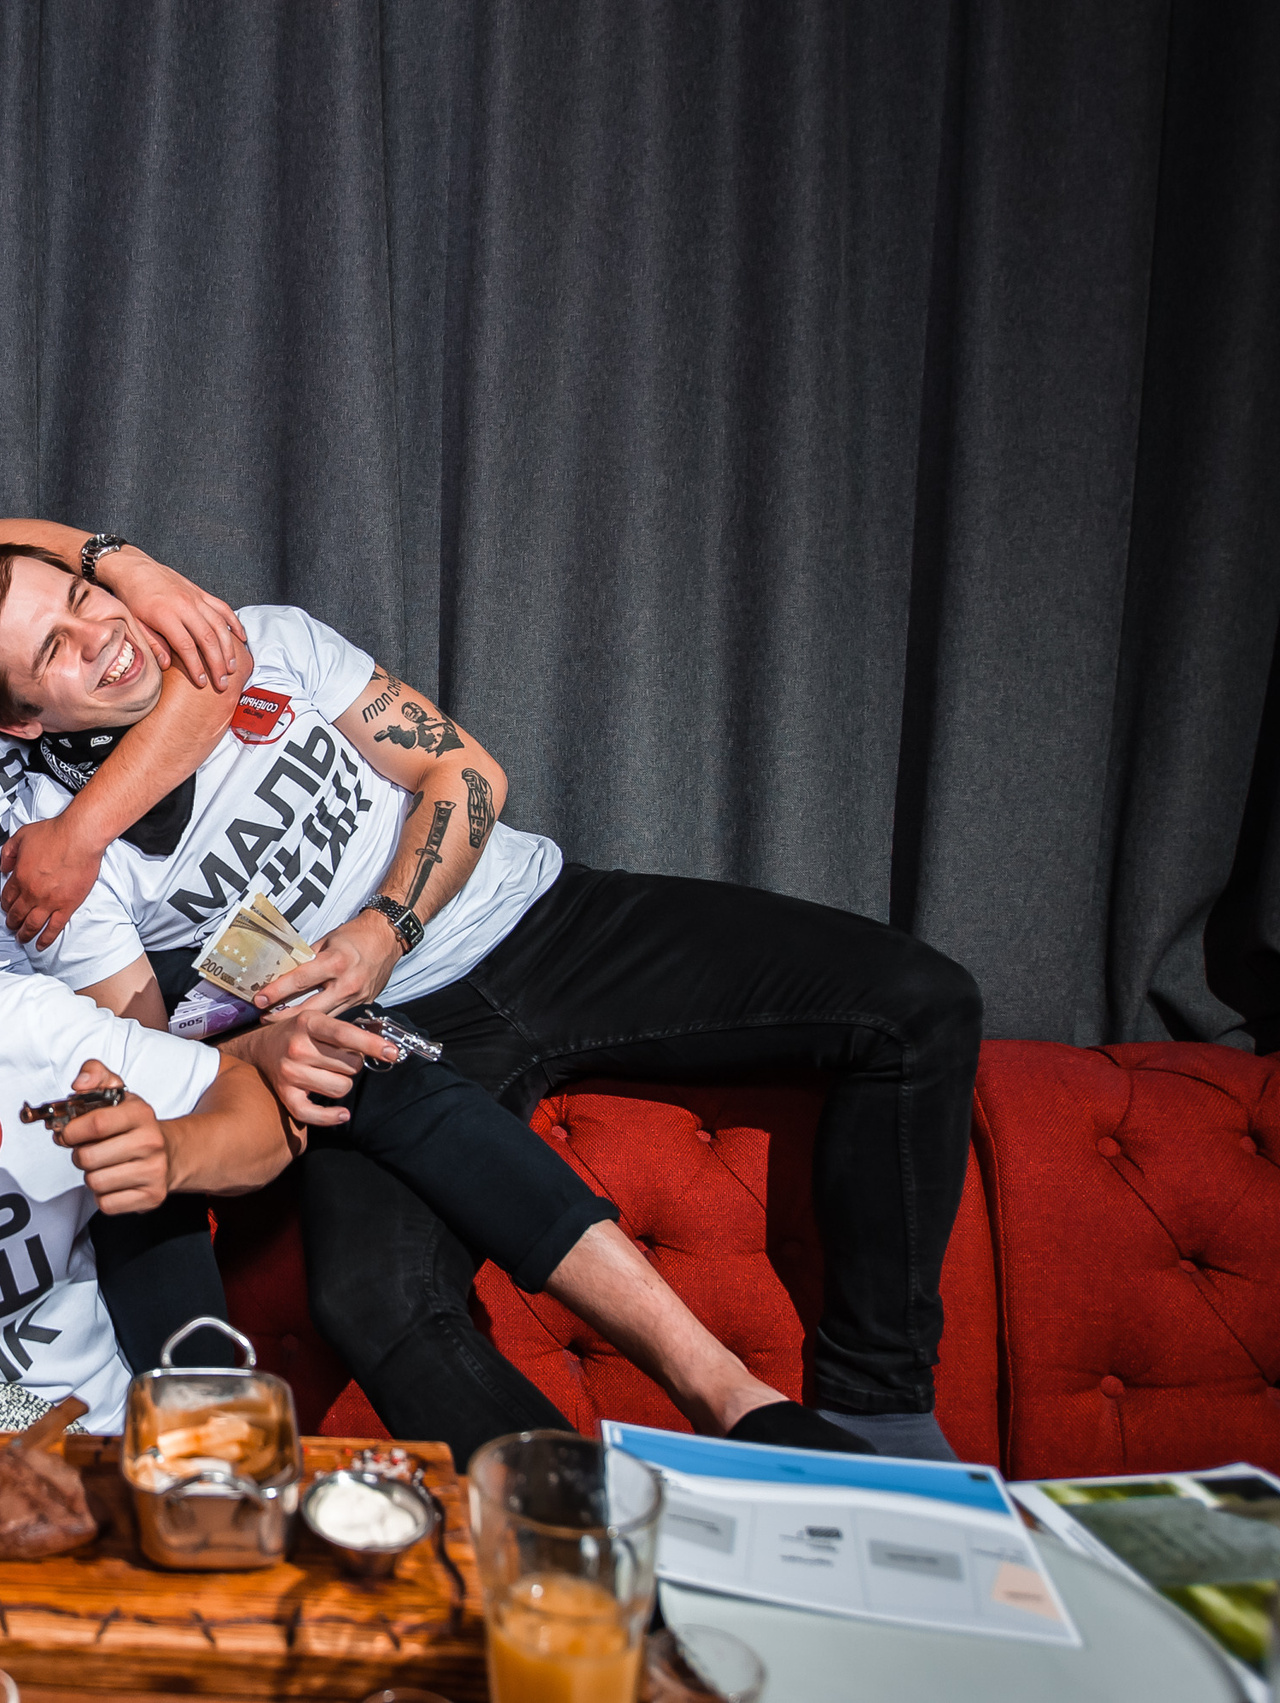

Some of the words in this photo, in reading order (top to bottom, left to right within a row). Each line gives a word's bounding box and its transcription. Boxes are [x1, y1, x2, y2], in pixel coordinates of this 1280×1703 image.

[167, 725, 336, 924] МАЛЬ
[200, 958, 223, 977] 200
[178, 1016, 203, 1029] 500
